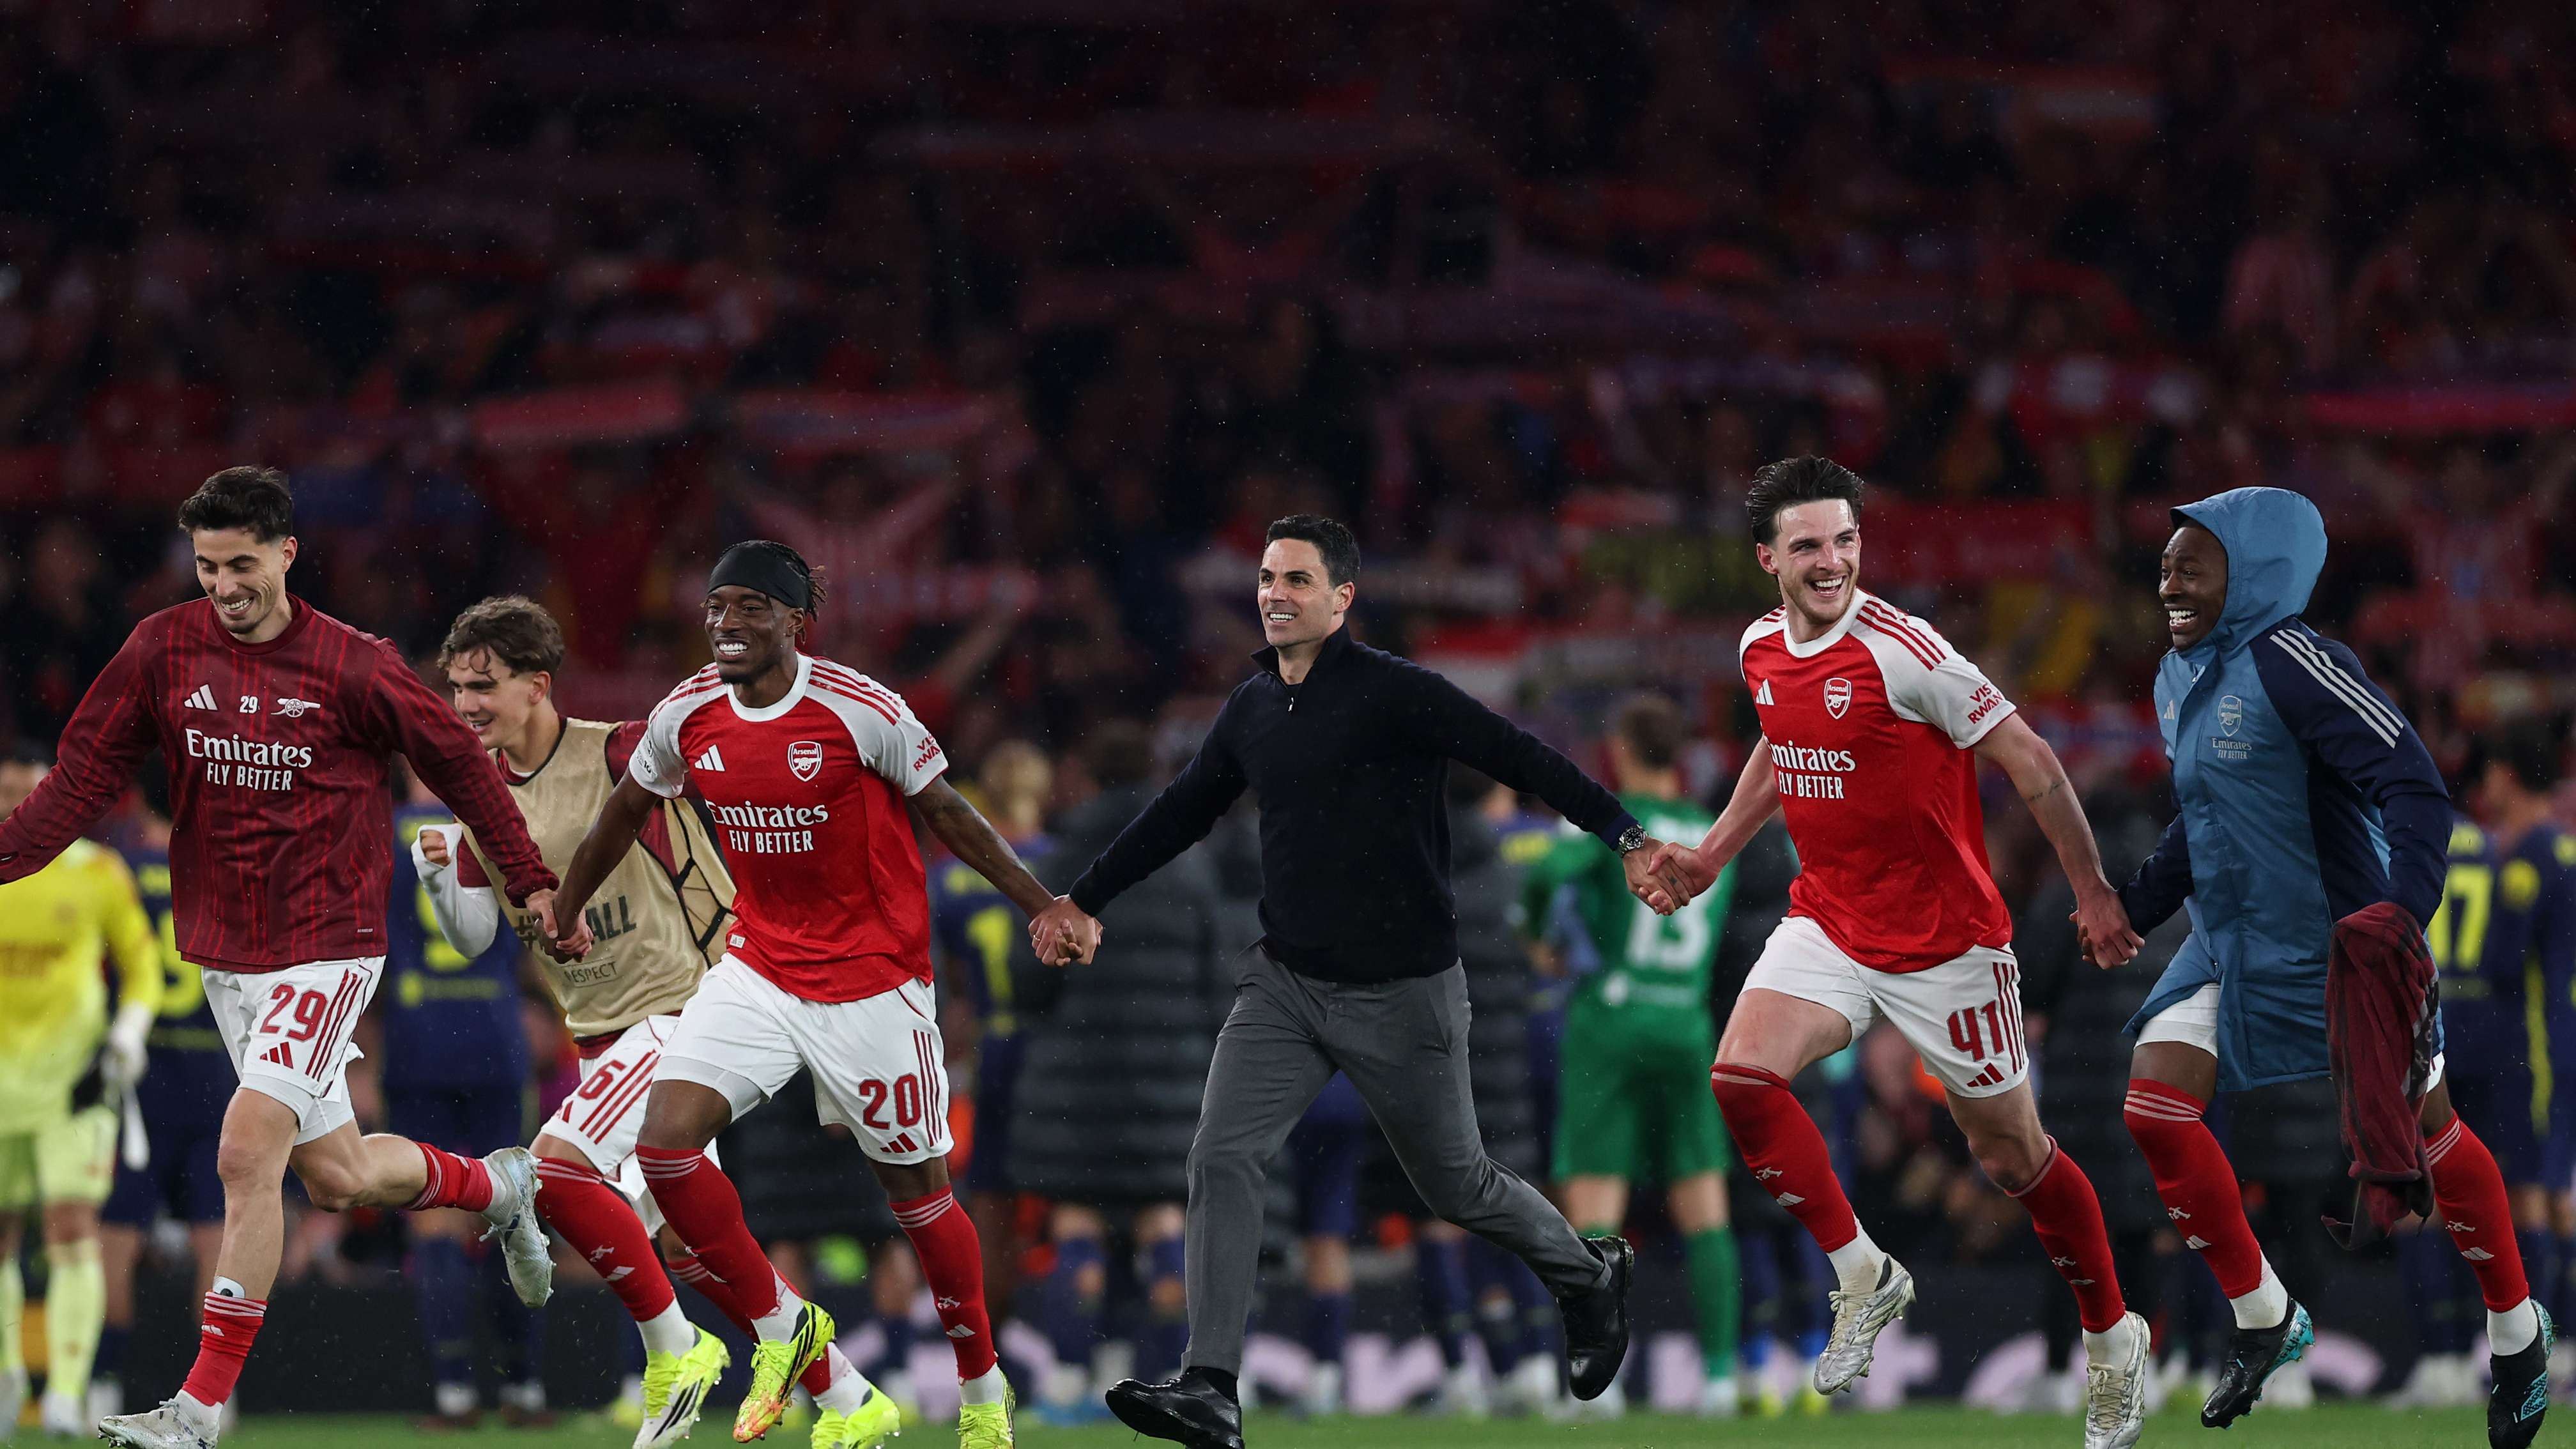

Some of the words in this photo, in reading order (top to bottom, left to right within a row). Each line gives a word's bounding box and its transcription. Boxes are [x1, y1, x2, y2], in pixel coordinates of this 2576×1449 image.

[240, 695, 258, 714] 29
[185, 728, 312, 768] Emirates
[1765, 735, 1856, 772] mirates
[2212, 737, 2252, 750] Emirates
[207, 762, 231, 786] FLY
[236, 765, 293, 791] BETTER
[1797, 774, 1844, 799] BETTER
[705, 799, 829, 827] Emirates
[729, 830, 749, 852] FLY
[755, 831, 814, 854] BETTER
[259, 983, 328, 1043] 29
[1946, 1000, 2005, 1062] 41
[858, 1072, 921, 1130] 20
